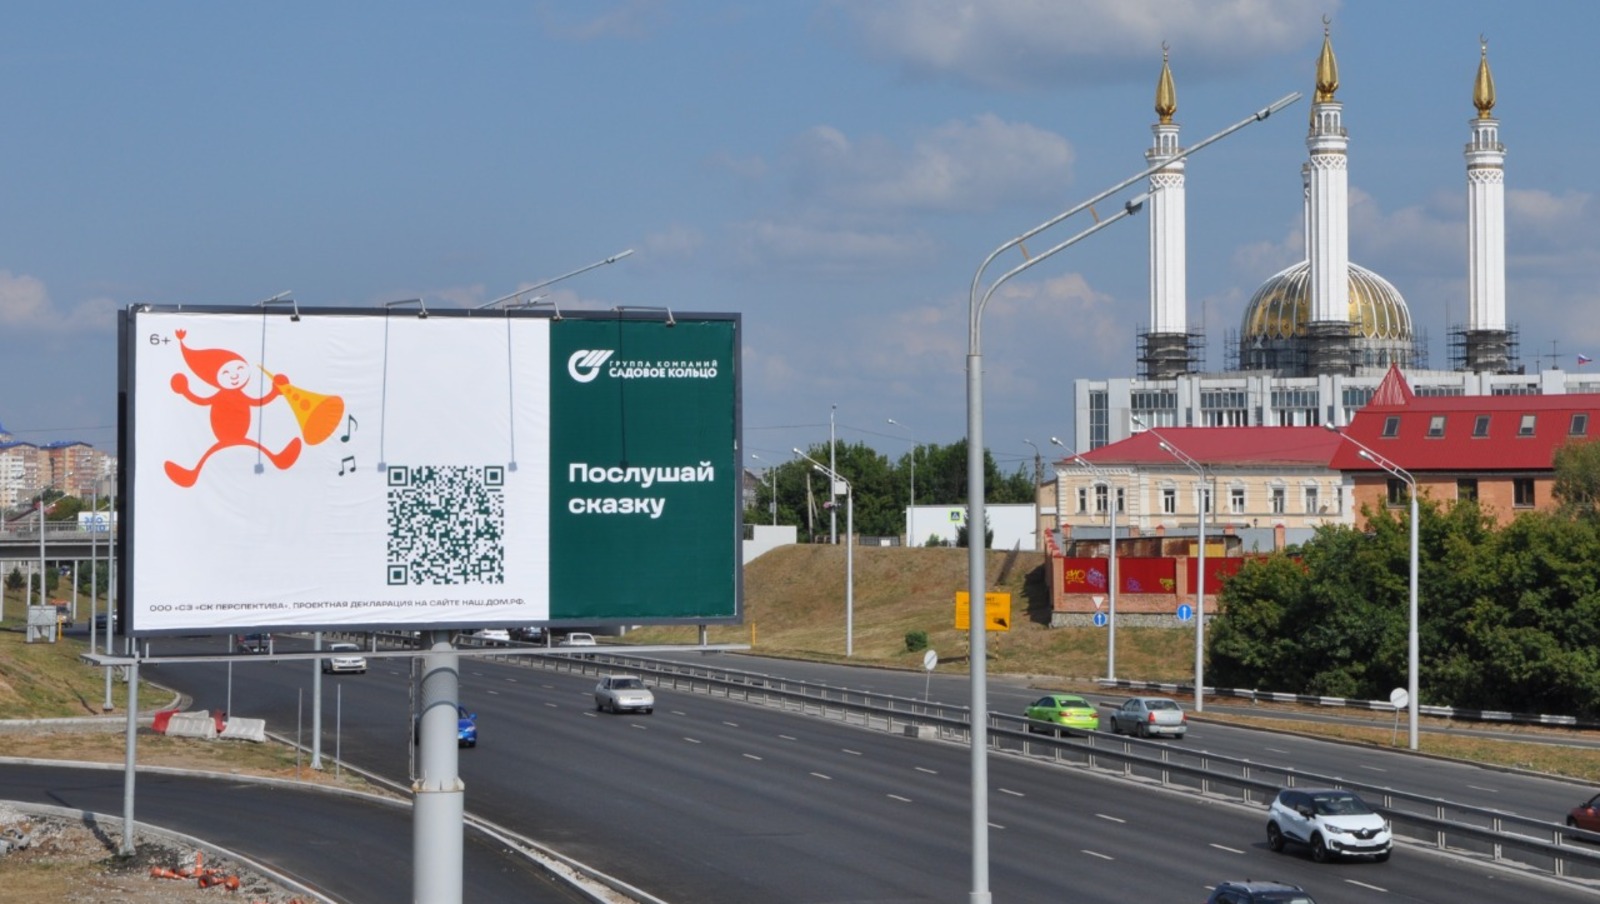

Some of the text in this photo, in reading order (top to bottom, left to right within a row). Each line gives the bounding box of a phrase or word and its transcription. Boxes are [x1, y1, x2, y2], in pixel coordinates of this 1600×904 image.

[150, 333, 171, 346] 6+
[657, 359, 718, 368] КОМПАНИЙ
[609, 367, 718, 379] САДОВОЕ КОЛЬЦО
[569, 461, 714, 488] Послушай
[568, 498, 665, 519] сказку
[149, 604, 172, 613] ООО
[293, 601, 348, 609] ПРОЕКТНАЯ
[350, 600, 413, 609] ДЕКЛАРАЦИЯ
[429, 598, 460, 607] САЙТЕ
